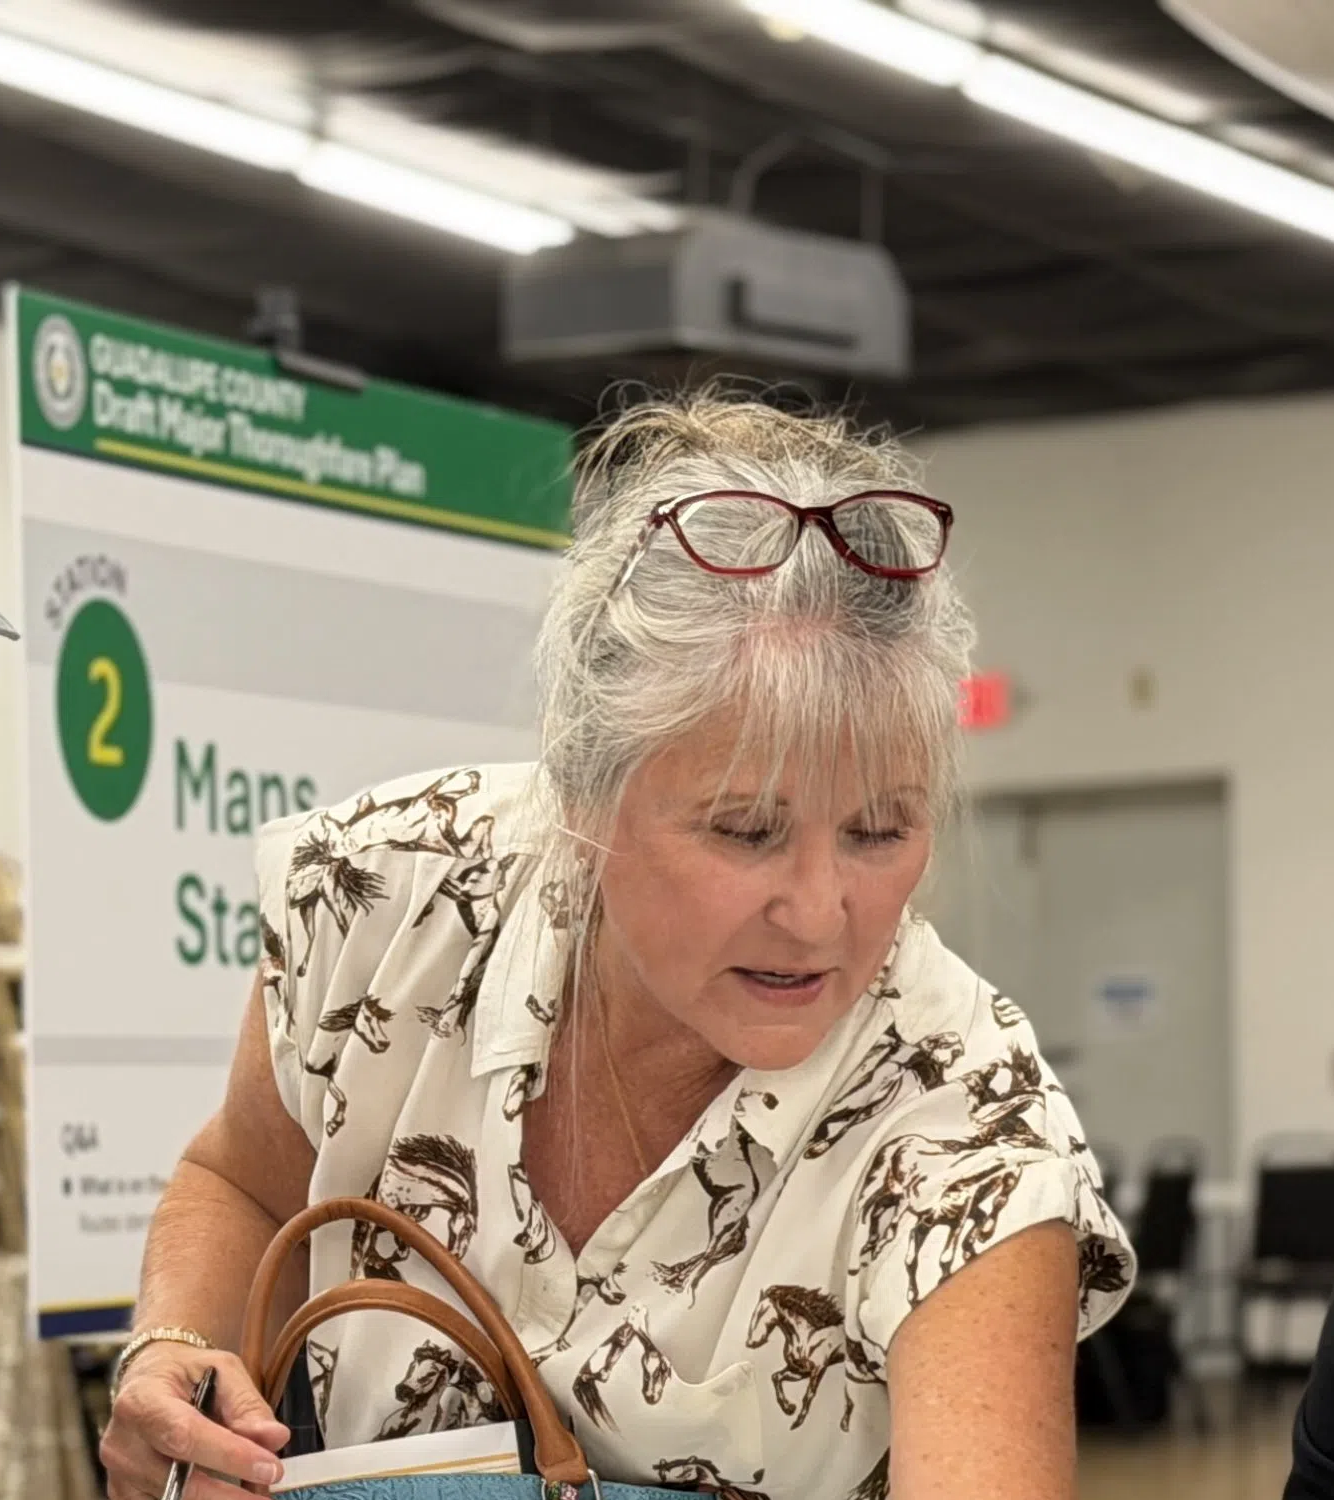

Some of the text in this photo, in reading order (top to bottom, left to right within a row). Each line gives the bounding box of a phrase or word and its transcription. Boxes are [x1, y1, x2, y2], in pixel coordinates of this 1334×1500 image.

[89, 333, 218, 402] GUADALUPE
[221, 366, 307, 424] COUNTY
[92, 379, 427, 498] Draft Major Thoroughfare Plan
[87, 656, 124, 767] 2
